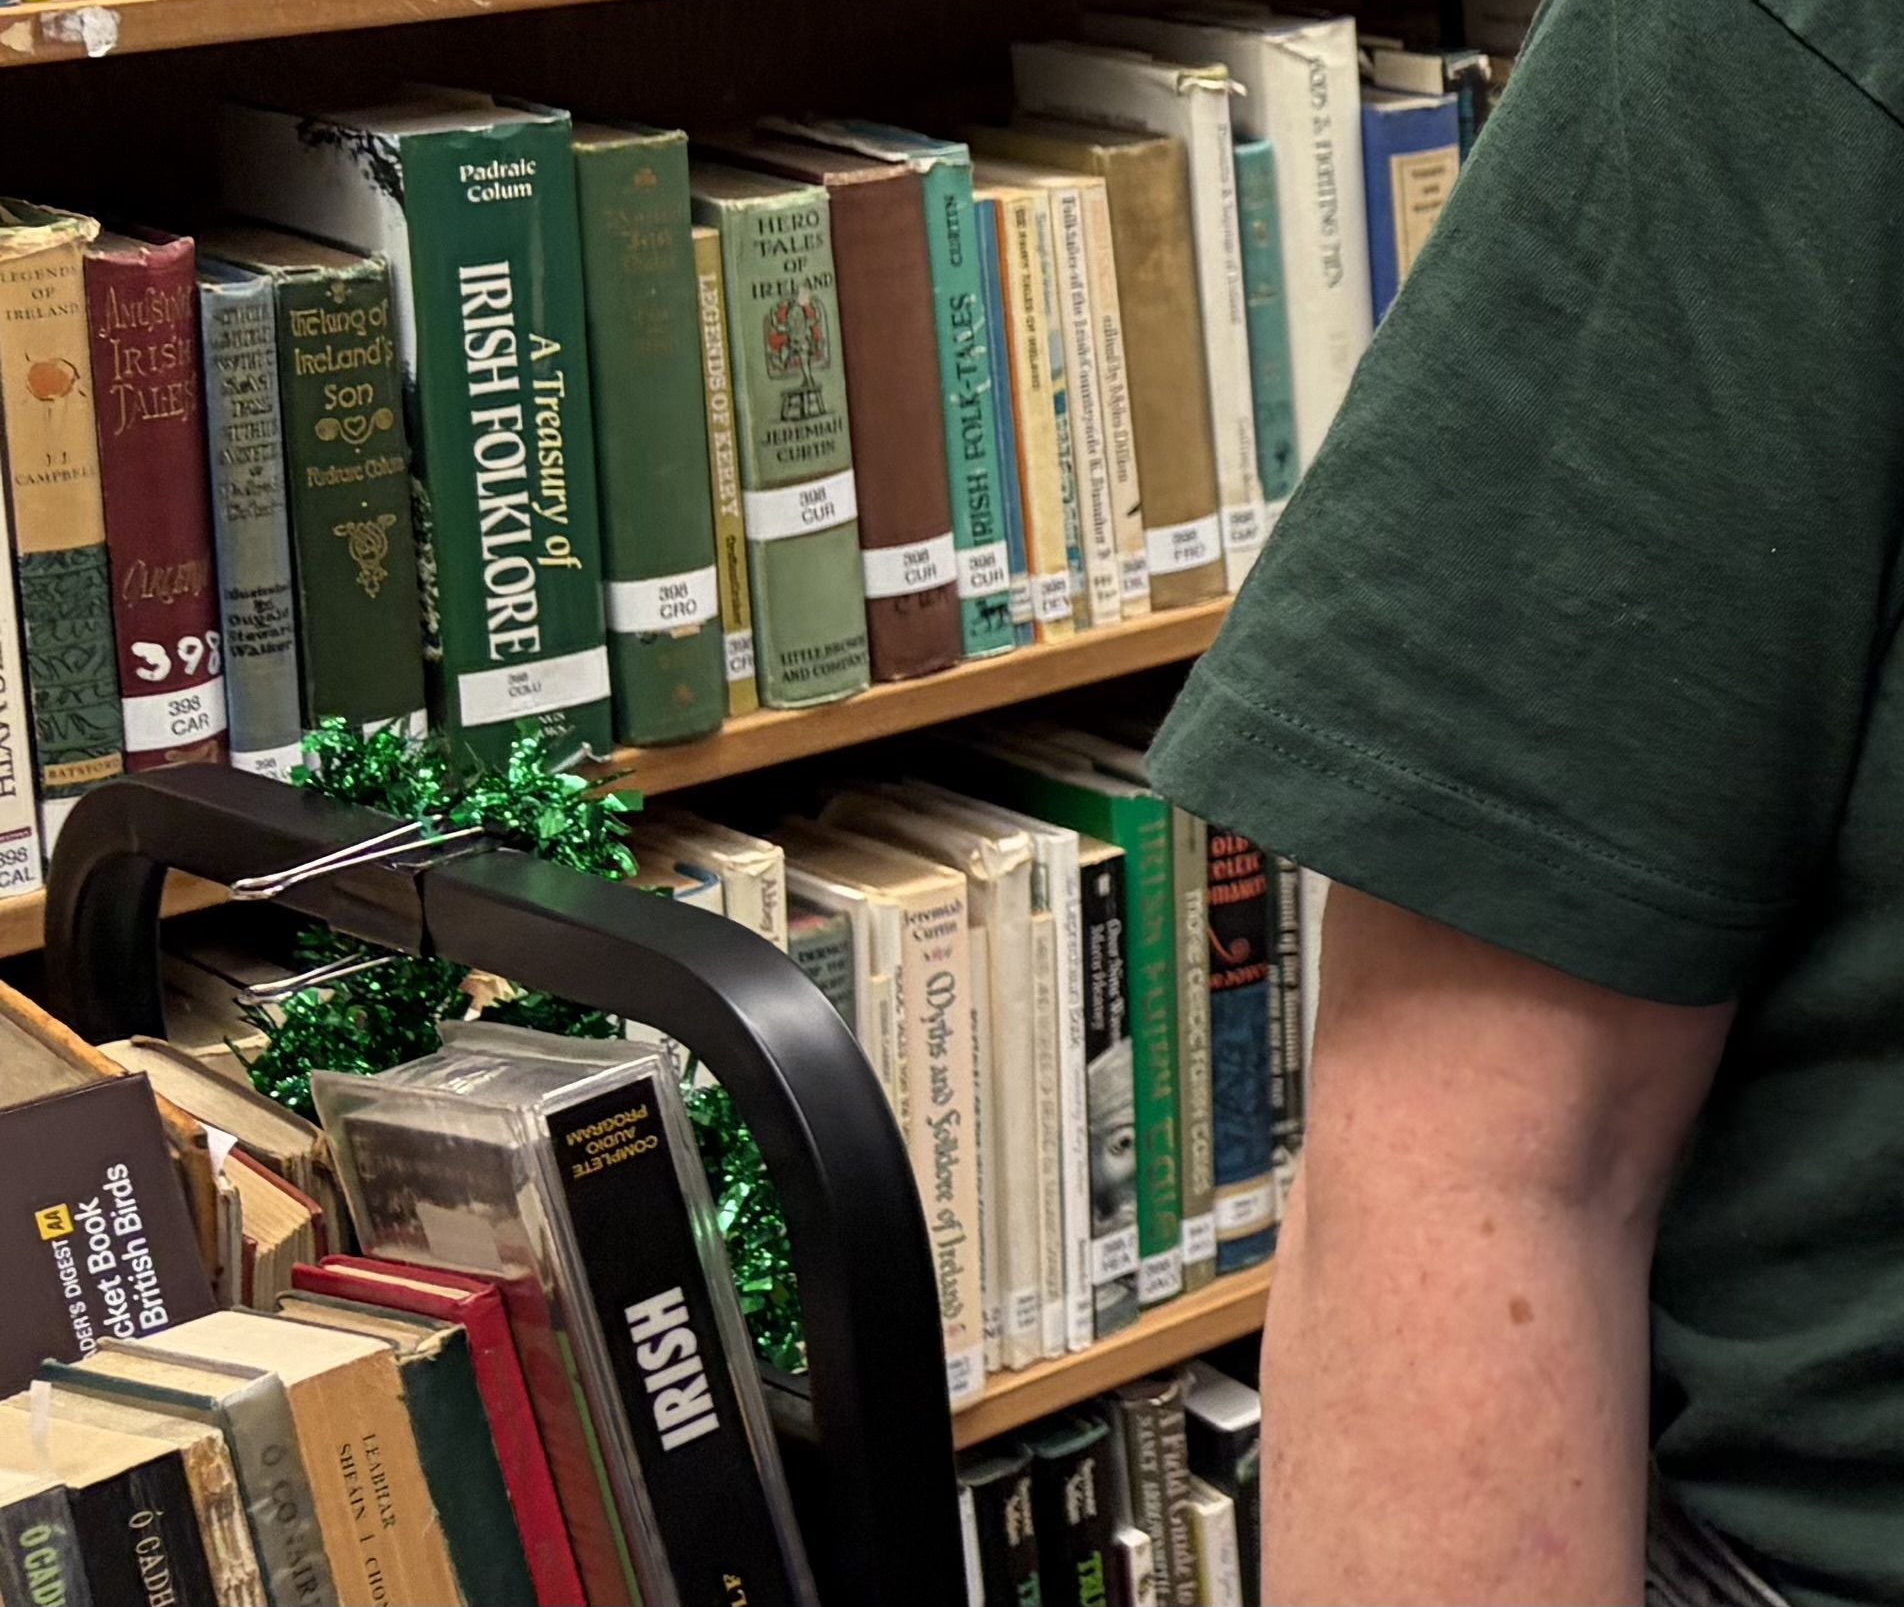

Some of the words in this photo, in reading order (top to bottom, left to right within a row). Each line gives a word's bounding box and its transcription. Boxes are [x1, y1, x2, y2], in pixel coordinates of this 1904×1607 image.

[459, 158, 537, 183] Padraic
[466, 180, 533, 203] Colum
[757, 211, 821, 235] HERO
[949, 194, 964, 268] CURTIN
[753, 234, 825, 259] TALES
[783, 255, 807, 273] OF
[751, 273, 834, 300] IRELAND
[459, 261, 520, 397] IRISH
[698, 272, 728, 392] LEGENDS
[529, 333, 561, 361] A
[950, 292, 986, 462] FOLK-TALES
[531, 370, 569, 525] Treasury
[760, 418, 845, 448] JEREMIAH
[776, 441, 837, 464] CURTIN
[801, 504, 836, 524] CUR
[470, 403, 541, 661] FOLKLORE
[537, 535, 583, 570] of
[659, 584, 689, 602] 398
[660, 598, 697, 620] CRO
[131, 630, 221, 682] 398
[167, 695, 201, 717] 398
[170, 713, 210, 736] CAR
[565, 1104, 650, 1147] PROGRAM
[585, 1125, 637, 1156] AUDIO
[571, 1134, 659, 1179] COMPLETE
[103, 1163, 143, 1236] Birds
[44, 1209, 66, 1231] AA
[74, 1196, 117, 1275] Book
[51, 1240, 82, 1299] DIGEST
[121, 1236, 169, 1330] British
[97, 1275, 136, 1340] cket
[623, 1285, 720, 1453] IRISH
[361, 1432, 399, 1532] LEABHAR
